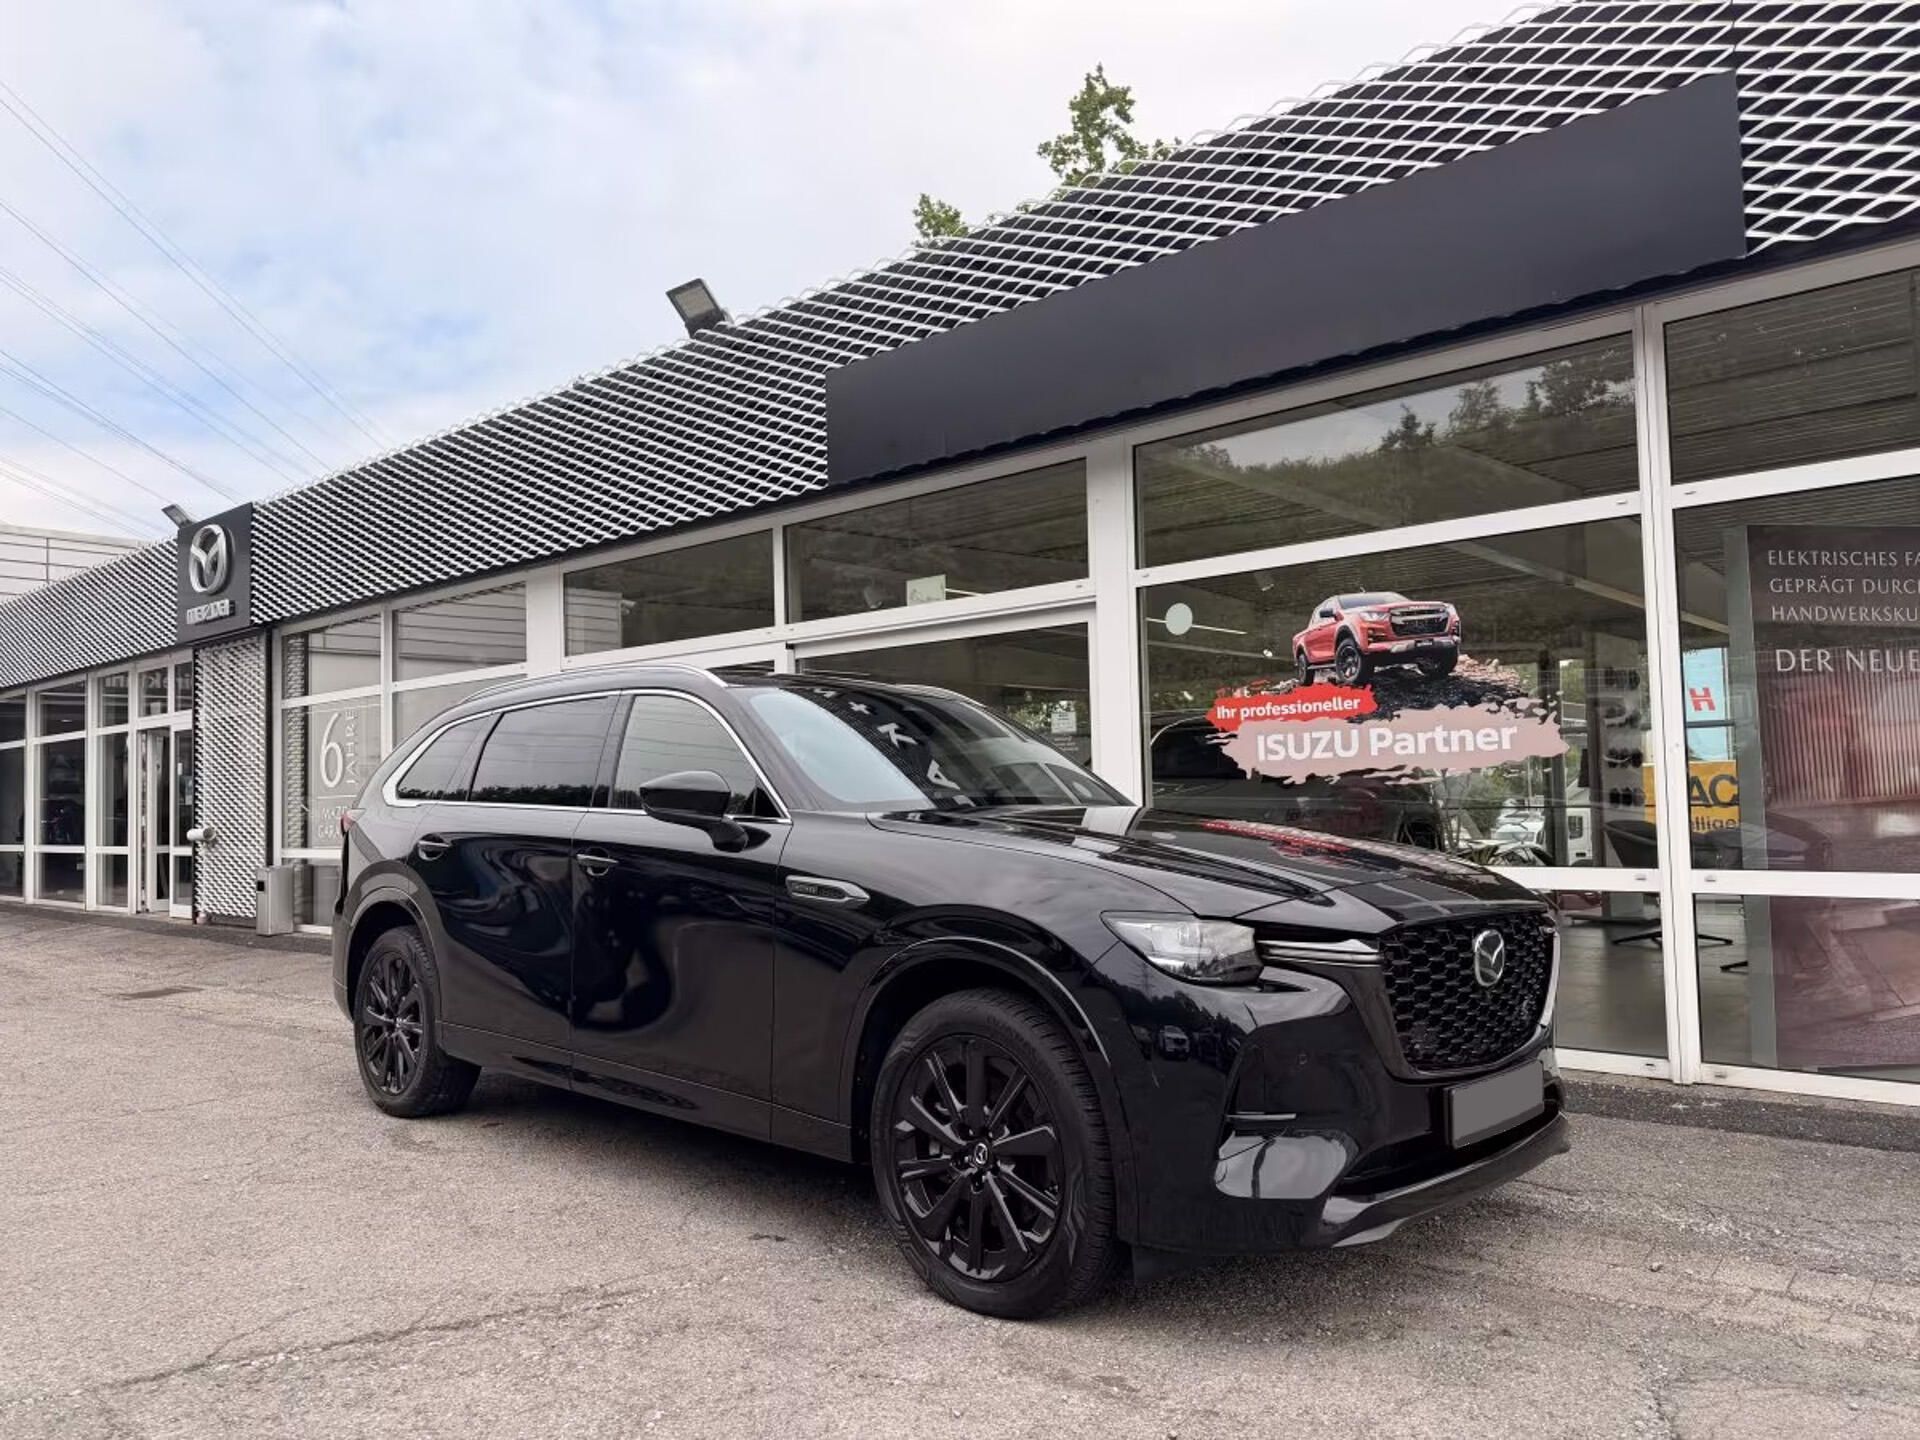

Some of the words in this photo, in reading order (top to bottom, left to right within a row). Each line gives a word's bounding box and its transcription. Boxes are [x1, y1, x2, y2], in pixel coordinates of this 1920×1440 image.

[1767, 549, 1898, 567] ELEKTRISCHES
[1769, 575, 1855, 594] GEPRÄGT
[1862, 578, 1920, 594] DURC
[1771, 605, 1918, 622] HANDWERKSKU
[1775, 648, 1834, 672] DER
[1845, 648, 1920, 673] NEUE
[1216, 705, 1236, 720] Ihr
[1240, 697, 1361, 721] professioneller
[320, 711, 343, 788] 6
[1256, 728, 1360, 762] ISUZU
[1368, 723, 1518, 757] Partner
[1689, 774, 1740, 808] AC
